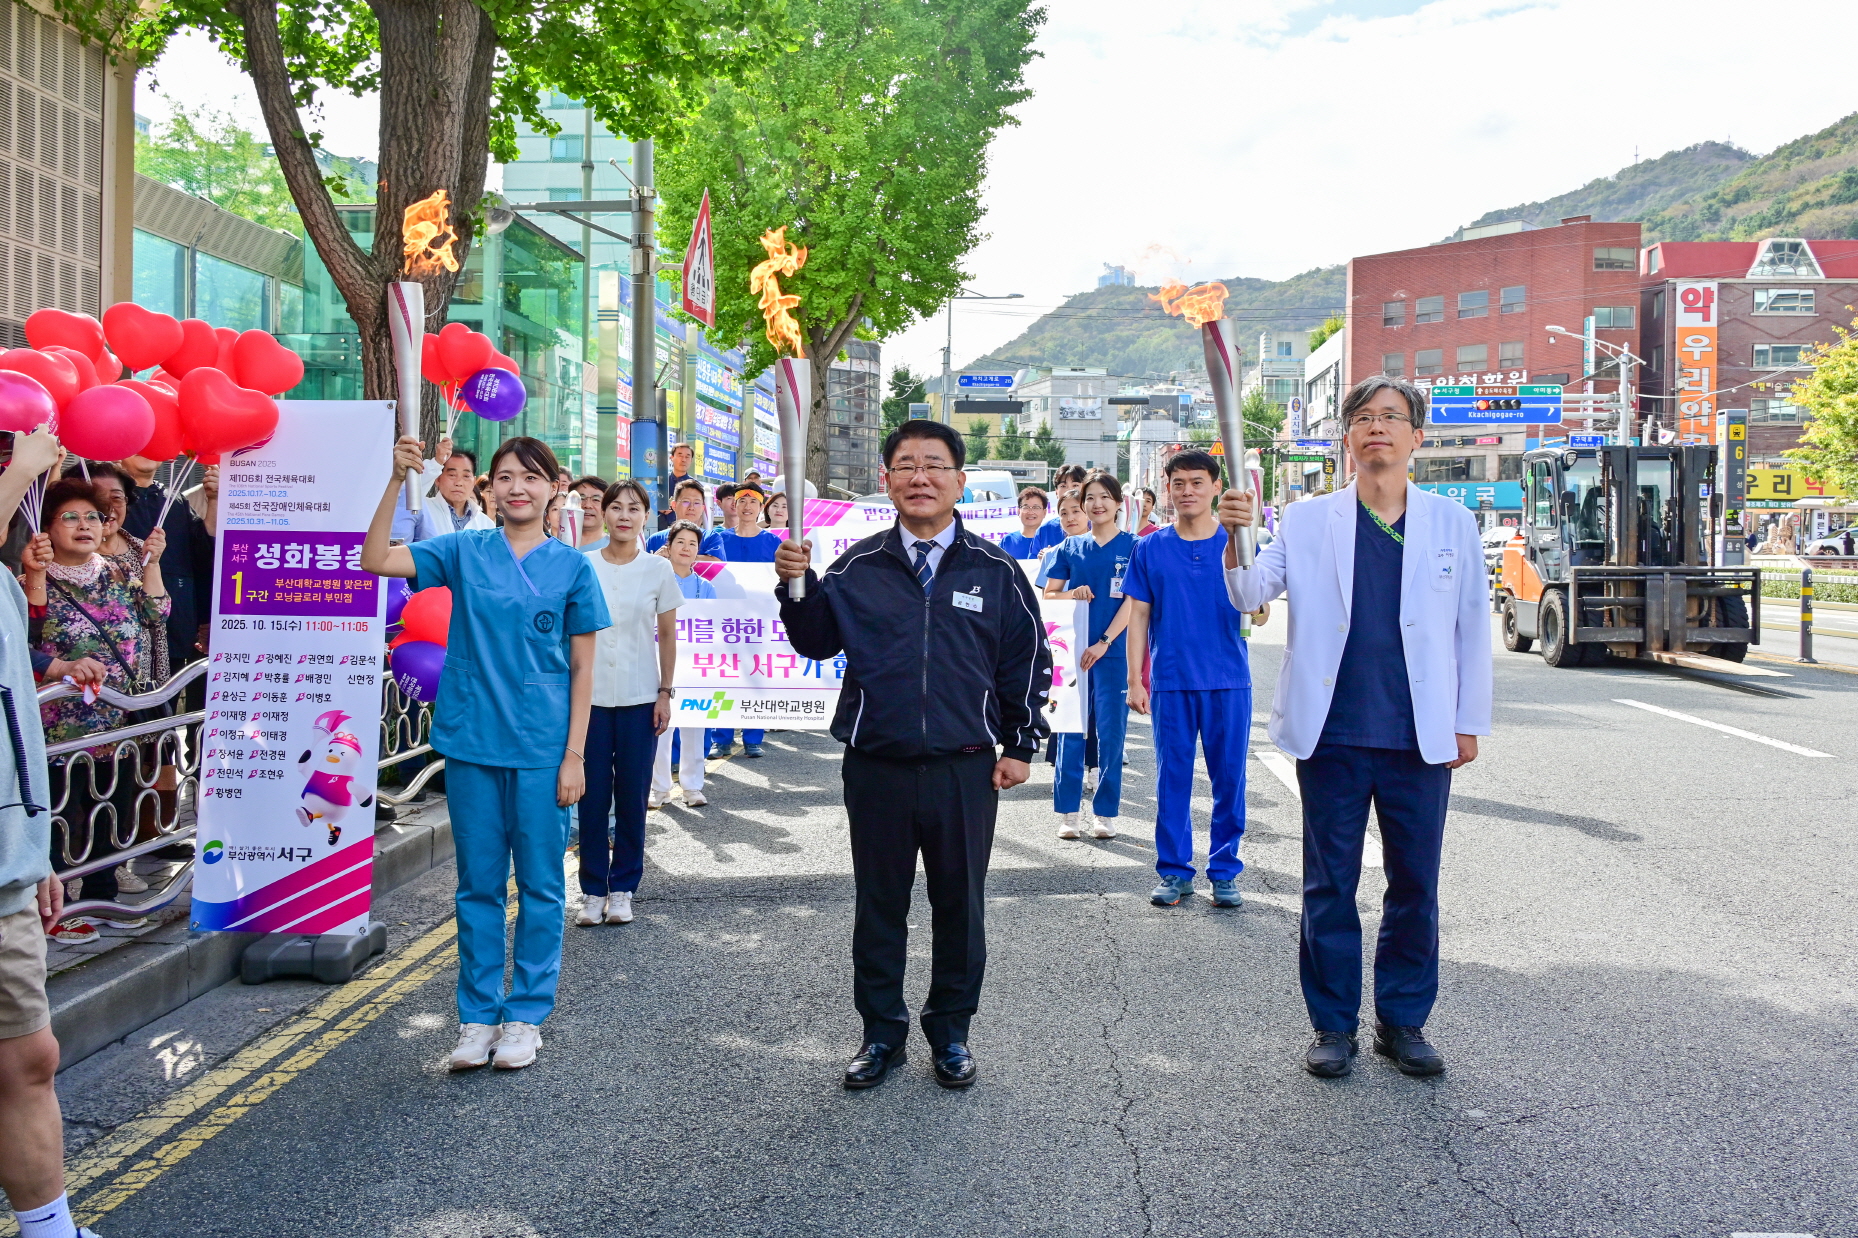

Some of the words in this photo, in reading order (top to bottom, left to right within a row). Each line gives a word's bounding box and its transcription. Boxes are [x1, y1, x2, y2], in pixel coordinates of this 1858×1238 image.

[1680, 286, 1714, 322] 약
[1468, 411, 1524, 420] Kkachigogae-ro
[1735, 446, 1744, 460] 6
[230, 474, 262, 483] 제106회
[266, 474, 316, 484] 전국체육대회
[1736, 468, 1743, 488] 토성
[252, 502, 331, 512] 전국장애인체육대회
[232, 544, 248, 552] 부산
[231, 554, 248, 563] 서구
[232, 572, 242, 604] 1
[274, 578, 341, 589] 부산대학교병원
[344, 579, 373, 590] 맞은편
[246, 590, 268, 602] 구간
[274, 592, 321, 603] 모닝글로리
[324, 593, 353, 603] 부민점
[221, 620, 248, 630] 2025.
[252, 620, 266, 630] 10.
[306, 621, 368, 632] 11:00~11:05
[654, 618, 714, 643] 리를
[721, 618, 764, 644] 향한
[224, 653, 250, 664] 강지민
[266, 654, 292, 664] 강혜진
[307, 654, 334, 664] 권연희
[350, 655, 376, 666] 김문석
[692, 653, 741, 678] 부산
[750, 653, 825, 678] 서구가
[223, 672, 249, 682] 김지혜
[264, 672, 290, 684] 박홍률
[305, 674, 332, 684] 배경민
[347, 674, 374, 685] 신현정
[222, 691, 246, 702] 윤상근
[262, 692, 287, 702] 이동훈
[307, 693, 332, 703] 이병호
[680, 699, 712, 710] PNU
[740, 700, 826, 714] 부산대학교병원
[220, 710, 246, 722] 이재명
[262, 711, 289, 722] 이재정
[220, 730, 245, 740] 이정규
[260, 730, 287, 741] 이태경
[259, 750, 286, 760] 전경원
[217, 768, 244, 779] 전민석
[259, 769, 284, 779] 조현우
[216, 788, 242, 798] 황병연
[228, 851, 275, 861] 부산광역시
[277, 847, 312, 862] 서구
